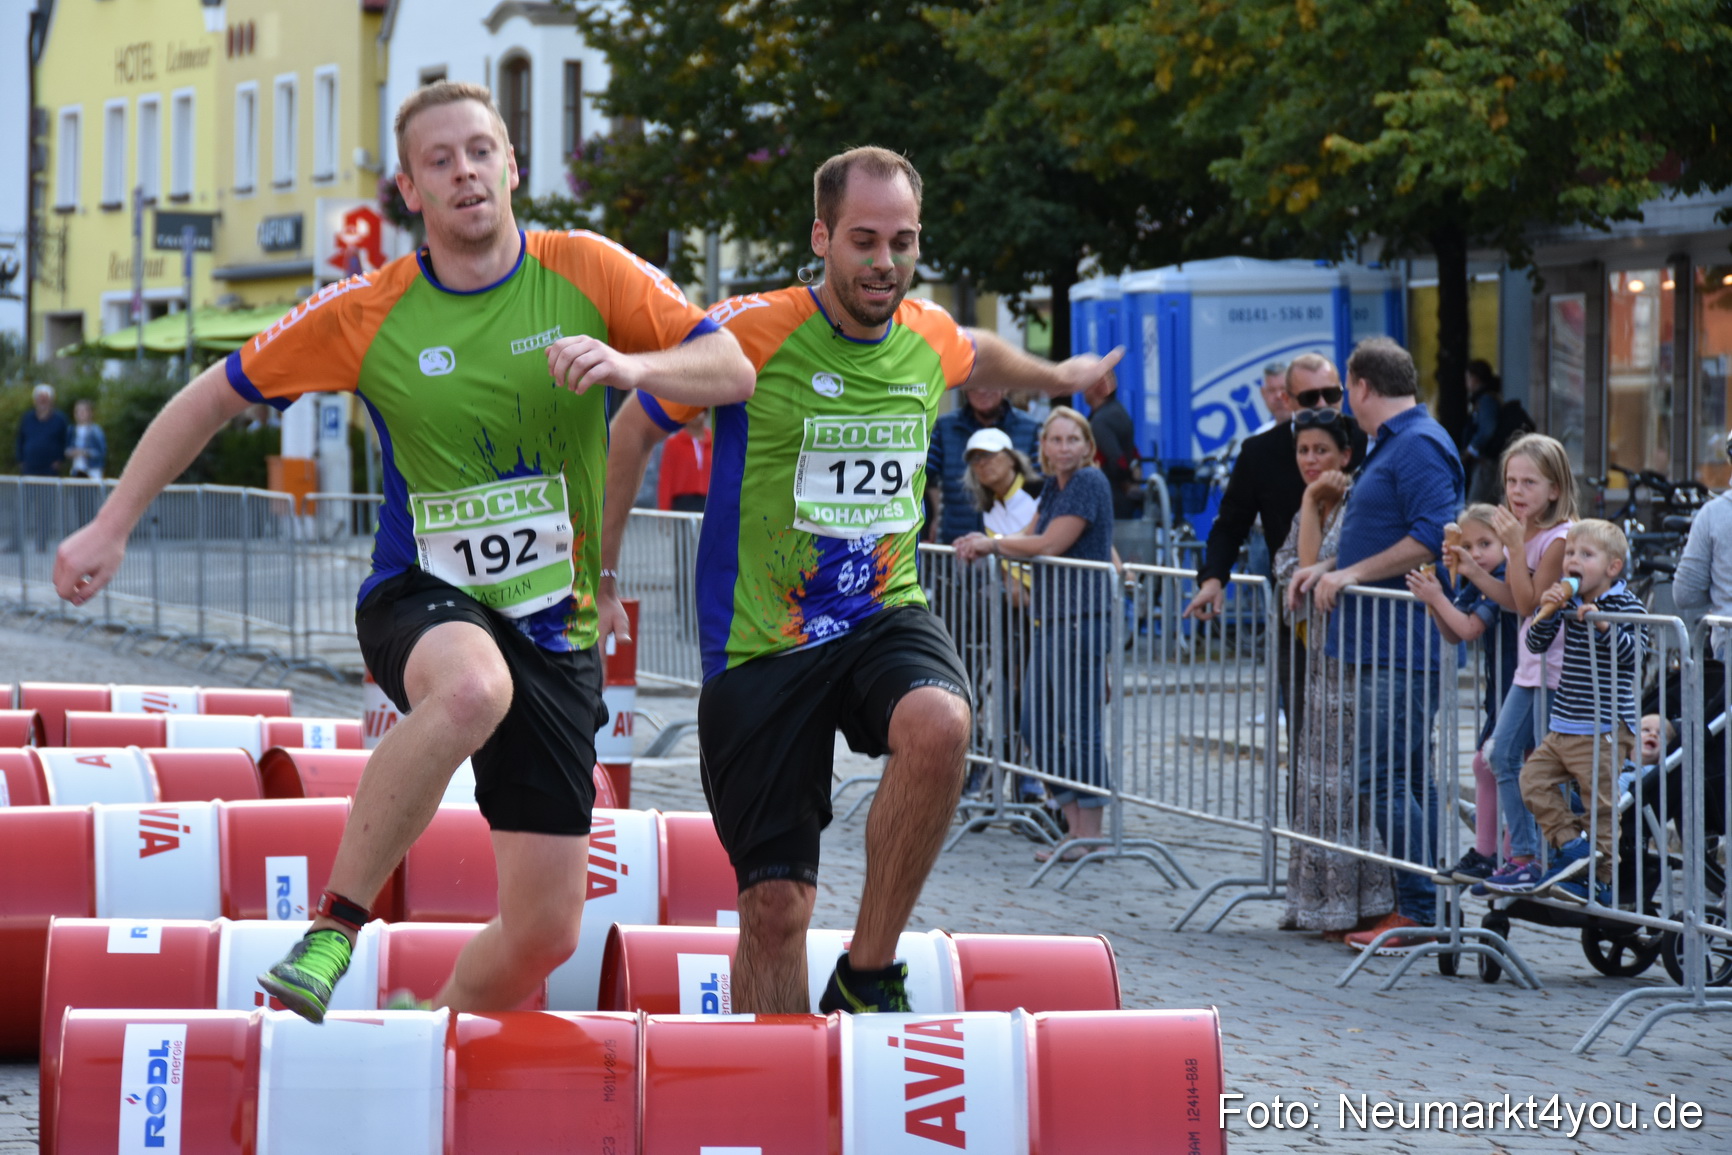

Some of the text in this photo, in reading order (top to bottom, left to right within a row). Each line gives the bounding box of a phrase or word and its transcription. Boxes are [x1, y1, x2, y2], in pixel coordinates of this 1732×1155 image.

[114, 41, 156, 85] HOTEL
[108, 251, 164, 281] Restrant
[511, 324, 563, 355] BOCK
[812, 421, 918, 449] BOCK
[828, 459, 903, 495] 129
[423, 480, 554, 530] BOCK
[453, 528, 539, 577] 192
[612, 711, 634, 738] AV
[139, 807, 191, 859] VIA
[701, 973, 719, 1014] DL
[171, 1040, 183, 1085] energie
[888, 1018, 966, 1150] AVIA
[1185, 1058, 1200, 1122] 12414-B&B
